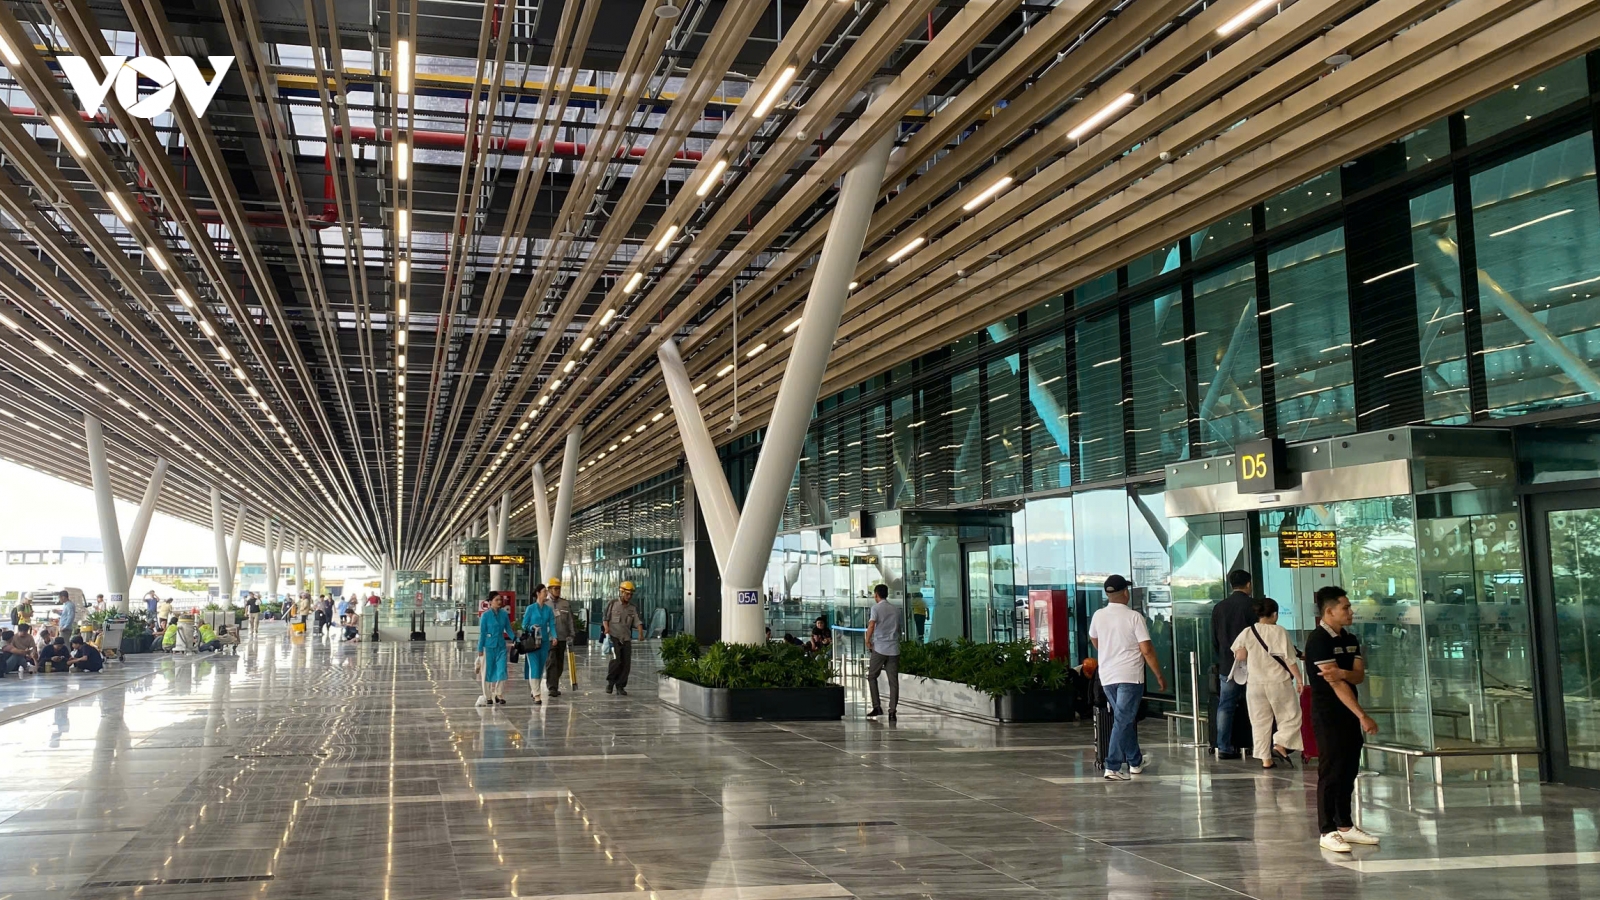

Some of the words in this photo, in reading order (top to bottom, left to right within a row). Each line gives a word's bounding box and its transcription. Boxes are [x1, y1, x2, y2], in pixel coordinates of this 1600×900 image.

[1242, 453, 1267, 480] D5
[850, 518, 859, 531] D4
[738, 592, 757, 603] 05A
